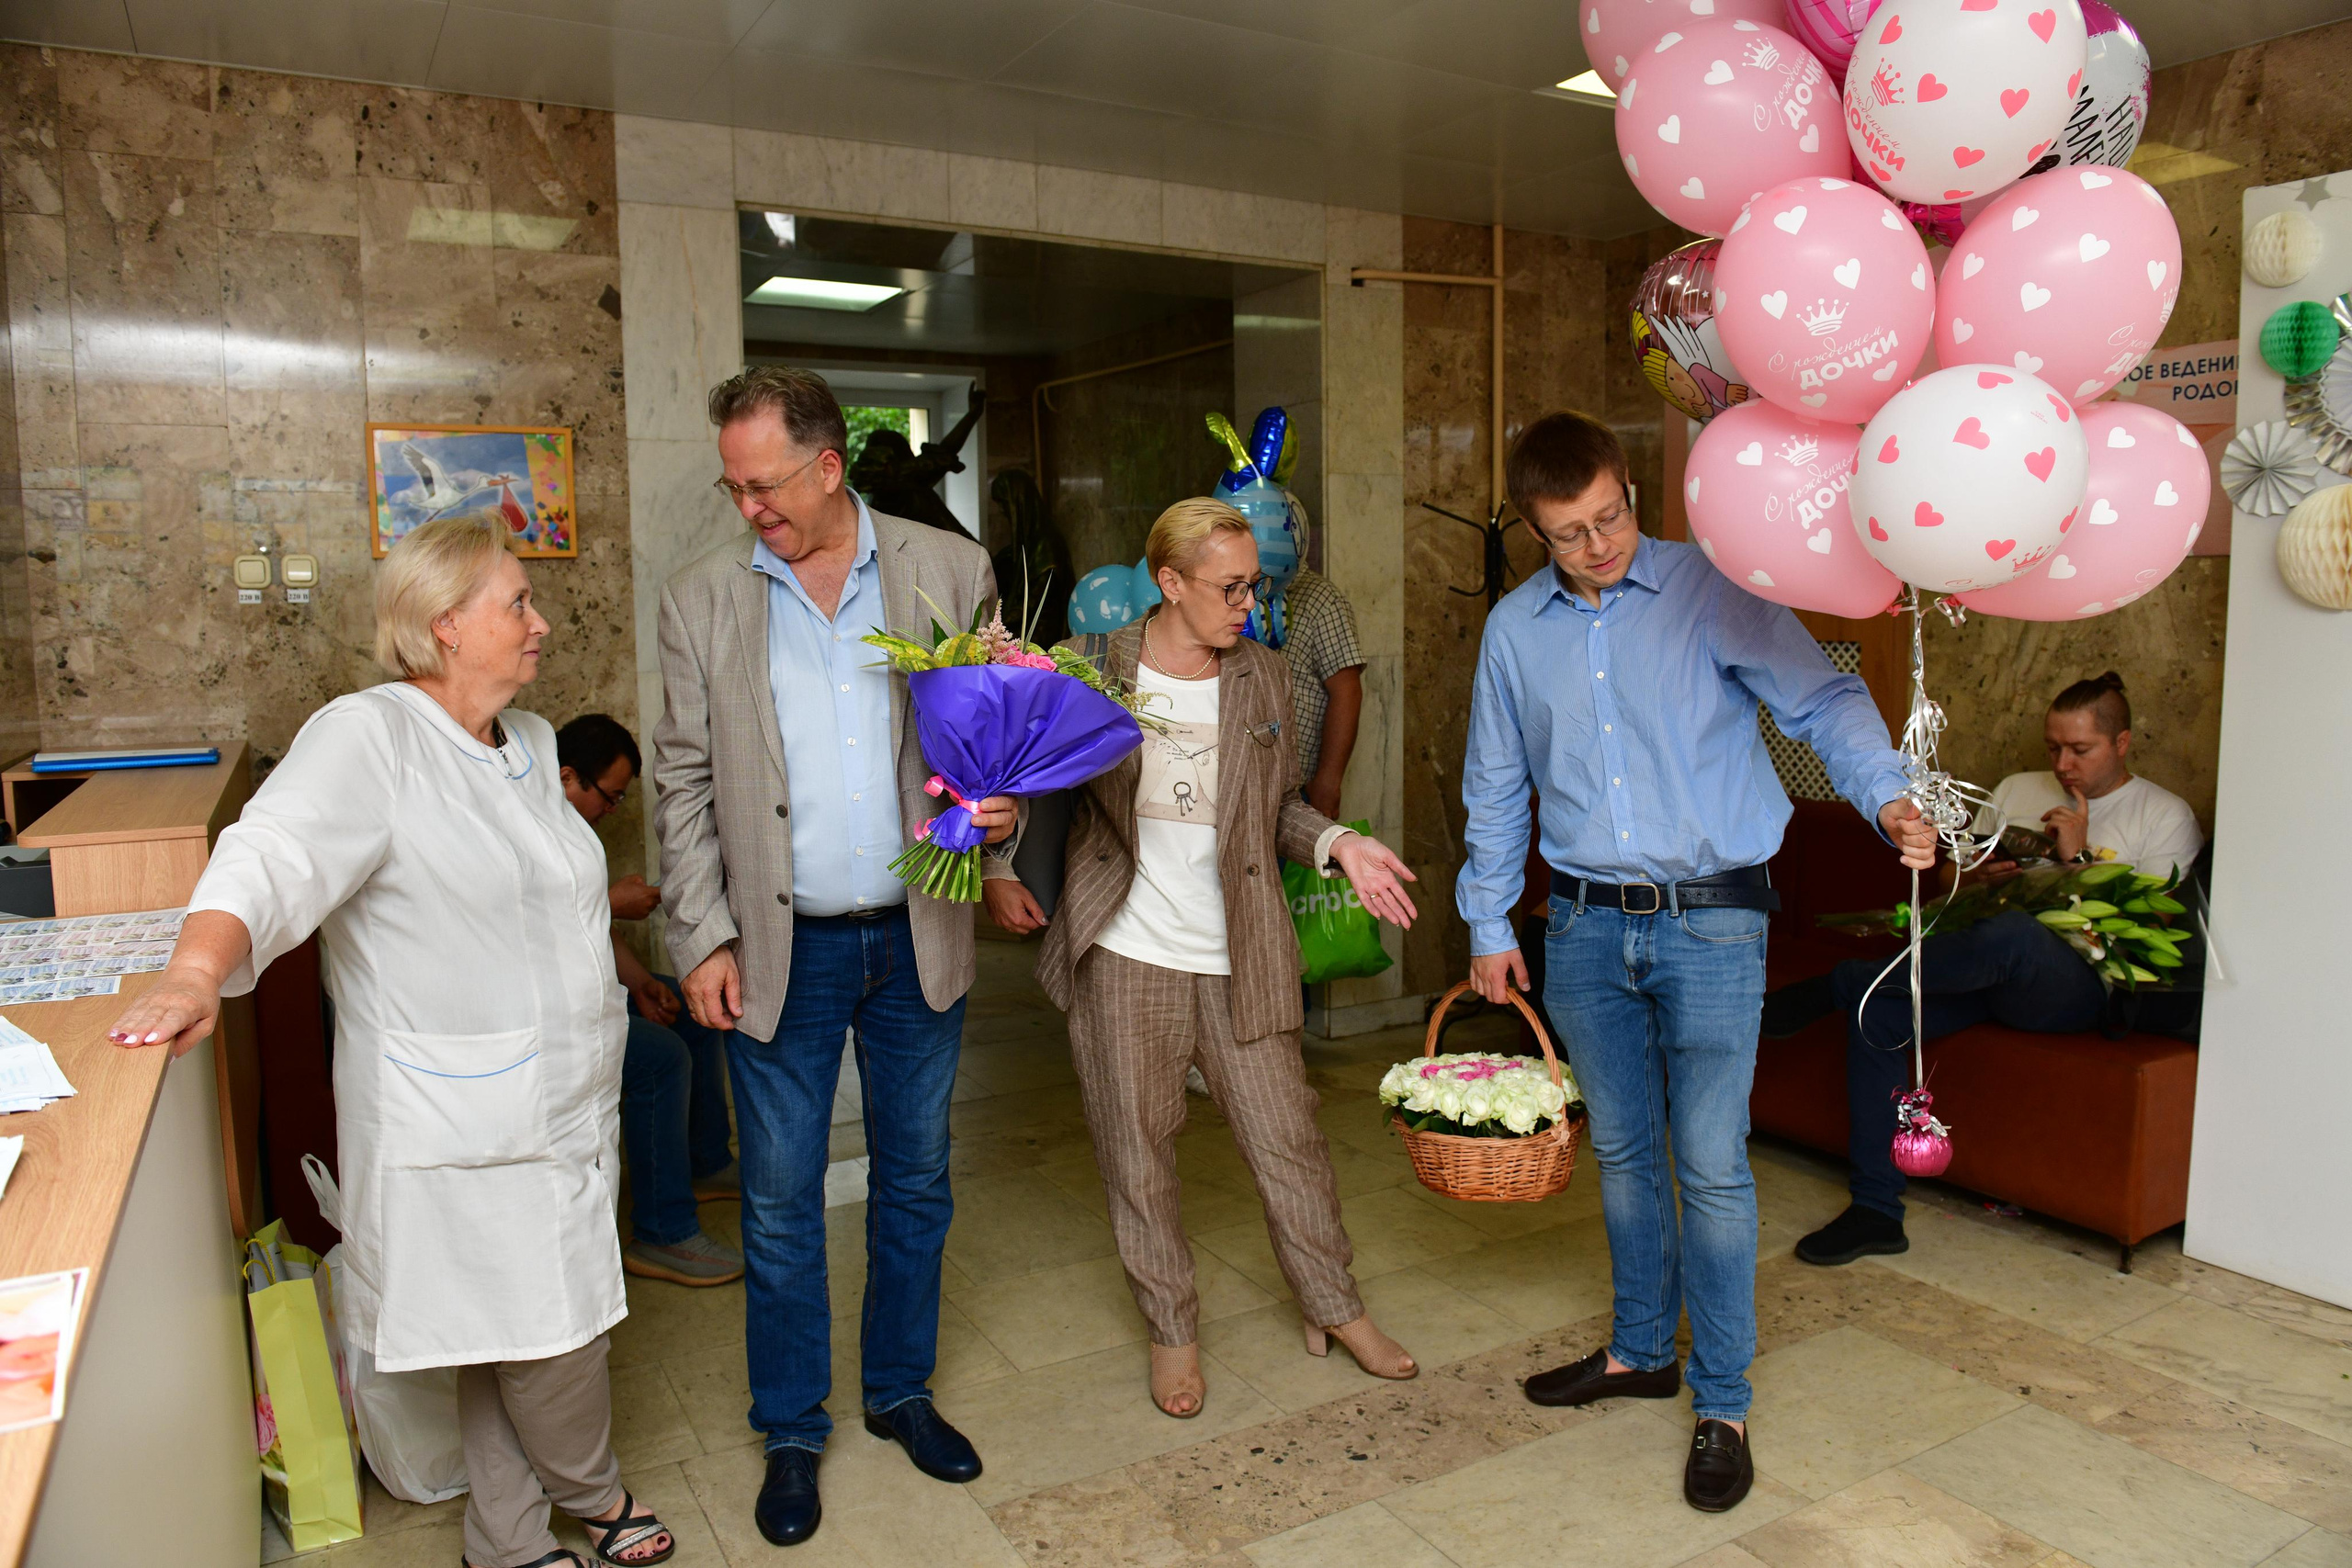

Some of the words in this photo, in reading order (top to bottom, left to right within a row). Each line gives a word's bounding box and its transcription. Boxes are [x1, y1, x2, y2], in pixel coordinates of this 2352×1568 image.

[1845, 90, 1905, 172] ДОЧКИ
[2064, 85, 2105, 165] МАЛЕ
[1791, 326, 1884, 381] рождением
[1800, 330, 1899, 390] ДОЧКИ
[1797, 470, 1850, 530] ДОЧ
